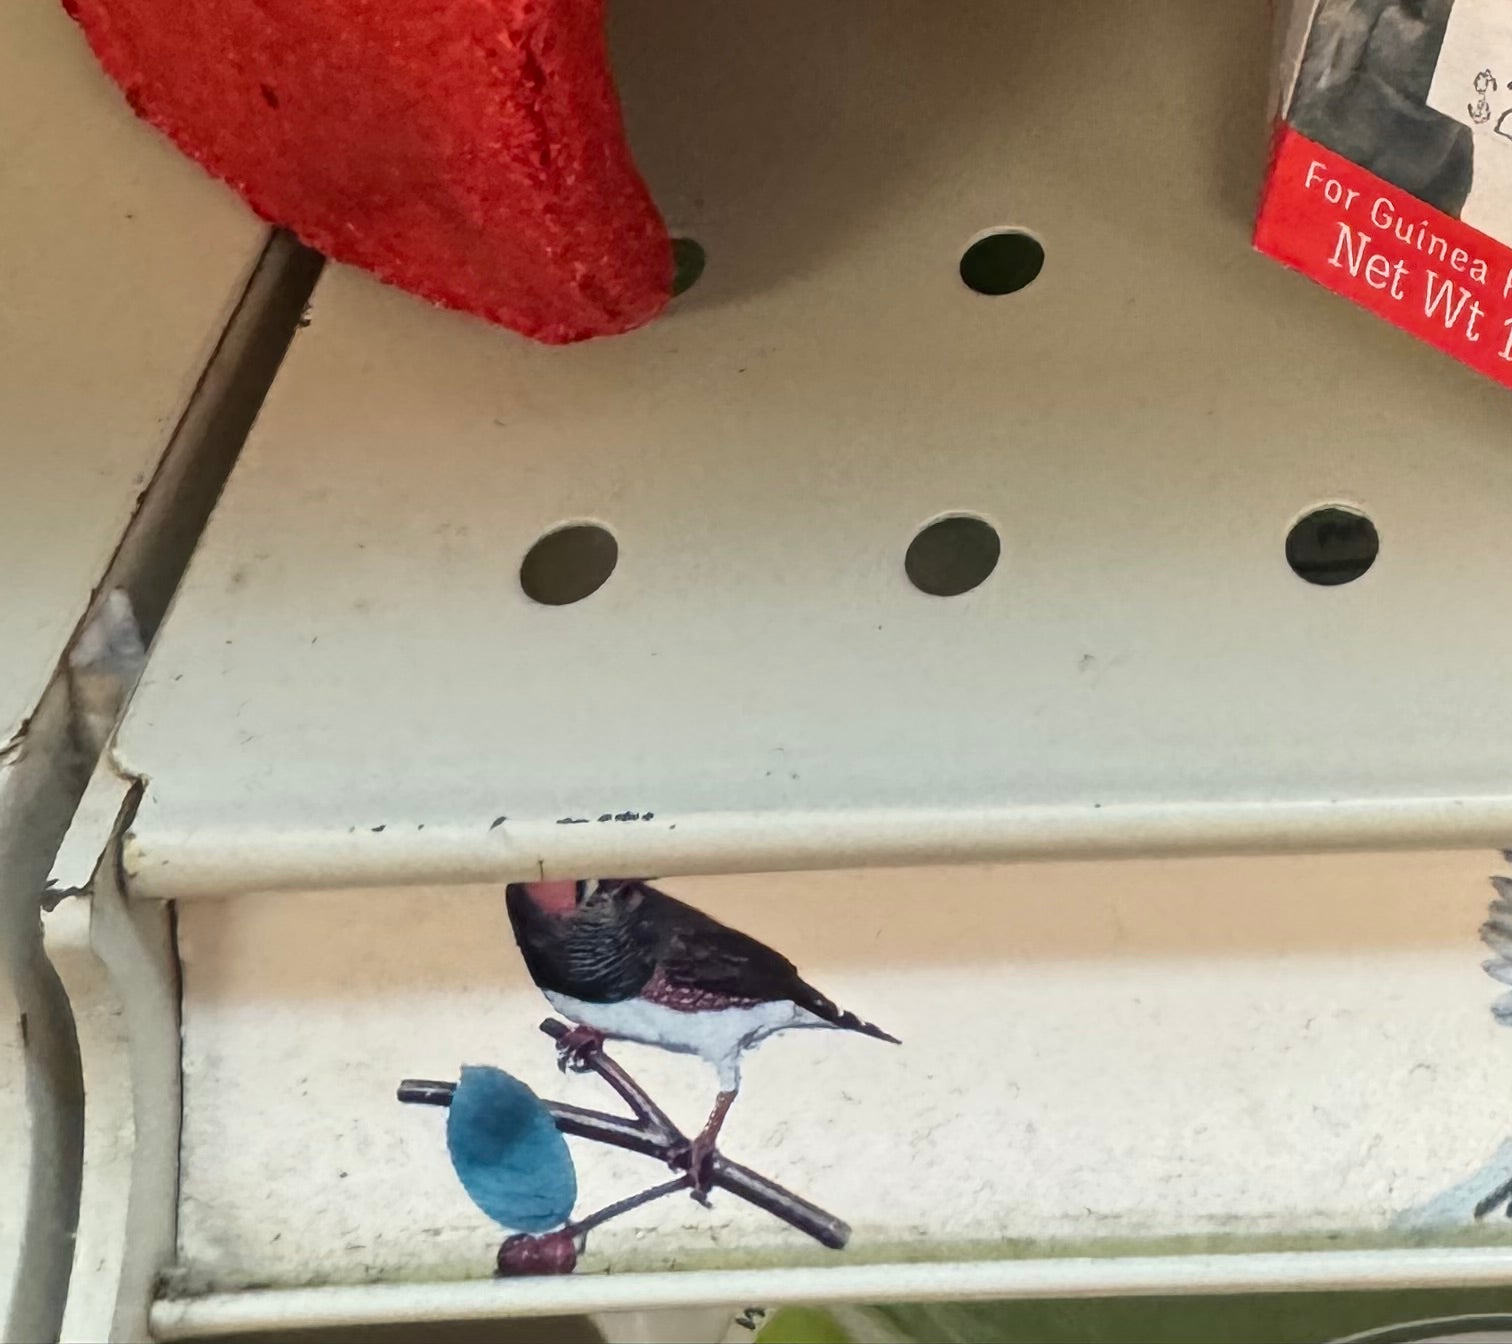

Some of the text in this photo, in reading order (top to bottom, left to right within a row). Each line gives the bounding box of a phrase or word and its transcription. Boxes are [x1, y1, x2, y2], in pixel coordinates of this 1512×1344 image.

[1304, 160, 1360, 210] For
[1371, 197, 1488, 284] Guinea
[1328, 221, 1409, 300] Net
[1424, 269, 1485, 341] Wt
